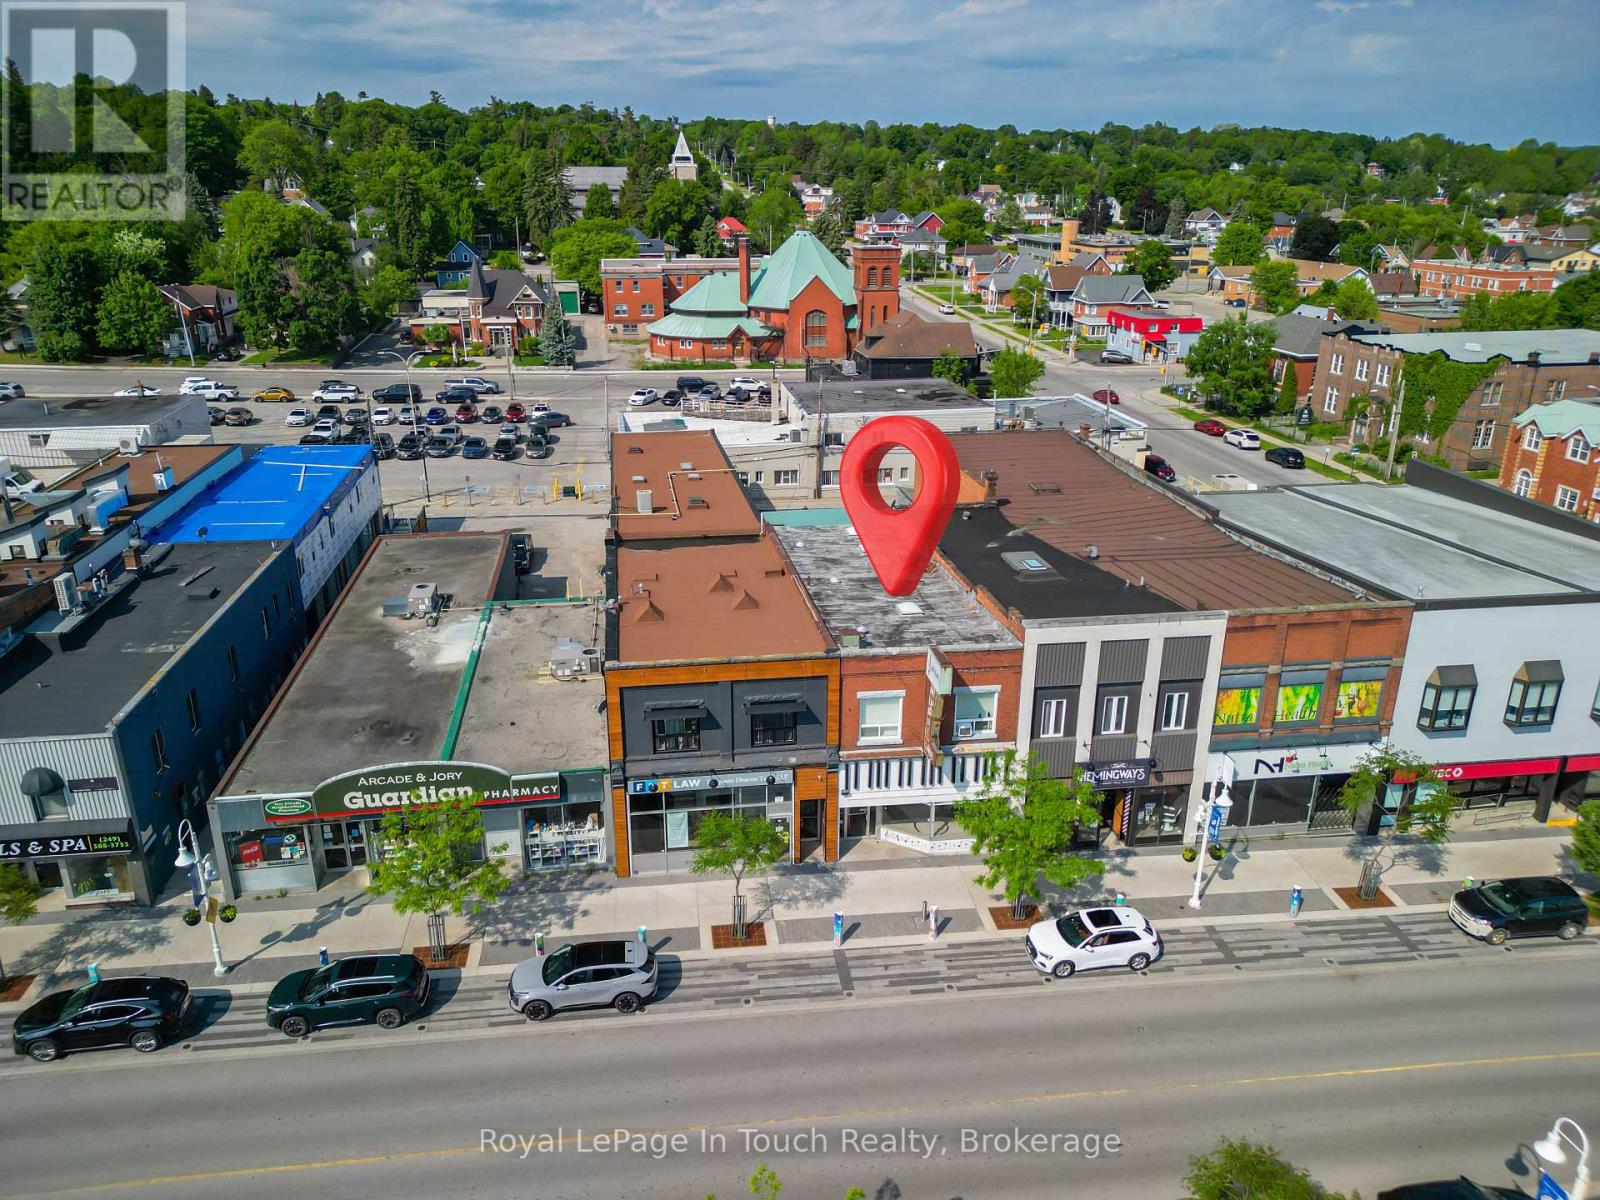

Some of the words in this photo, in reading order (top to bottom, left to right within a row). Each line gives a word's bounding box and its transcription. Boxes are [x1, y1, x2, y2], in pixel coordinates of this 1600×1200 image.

[358, 775, 413, 786] ARCADE
[415, 773, 426, 782] &
[429, 772, 463, 781] JORY
[673, 779, 700, 788] LAW
[343, 785, 473, 809] Guardian
[484, 785, 559, 799] PHARMACY
[28, 841, 43, 854] &
[49, 838, 87, 852] SPA
